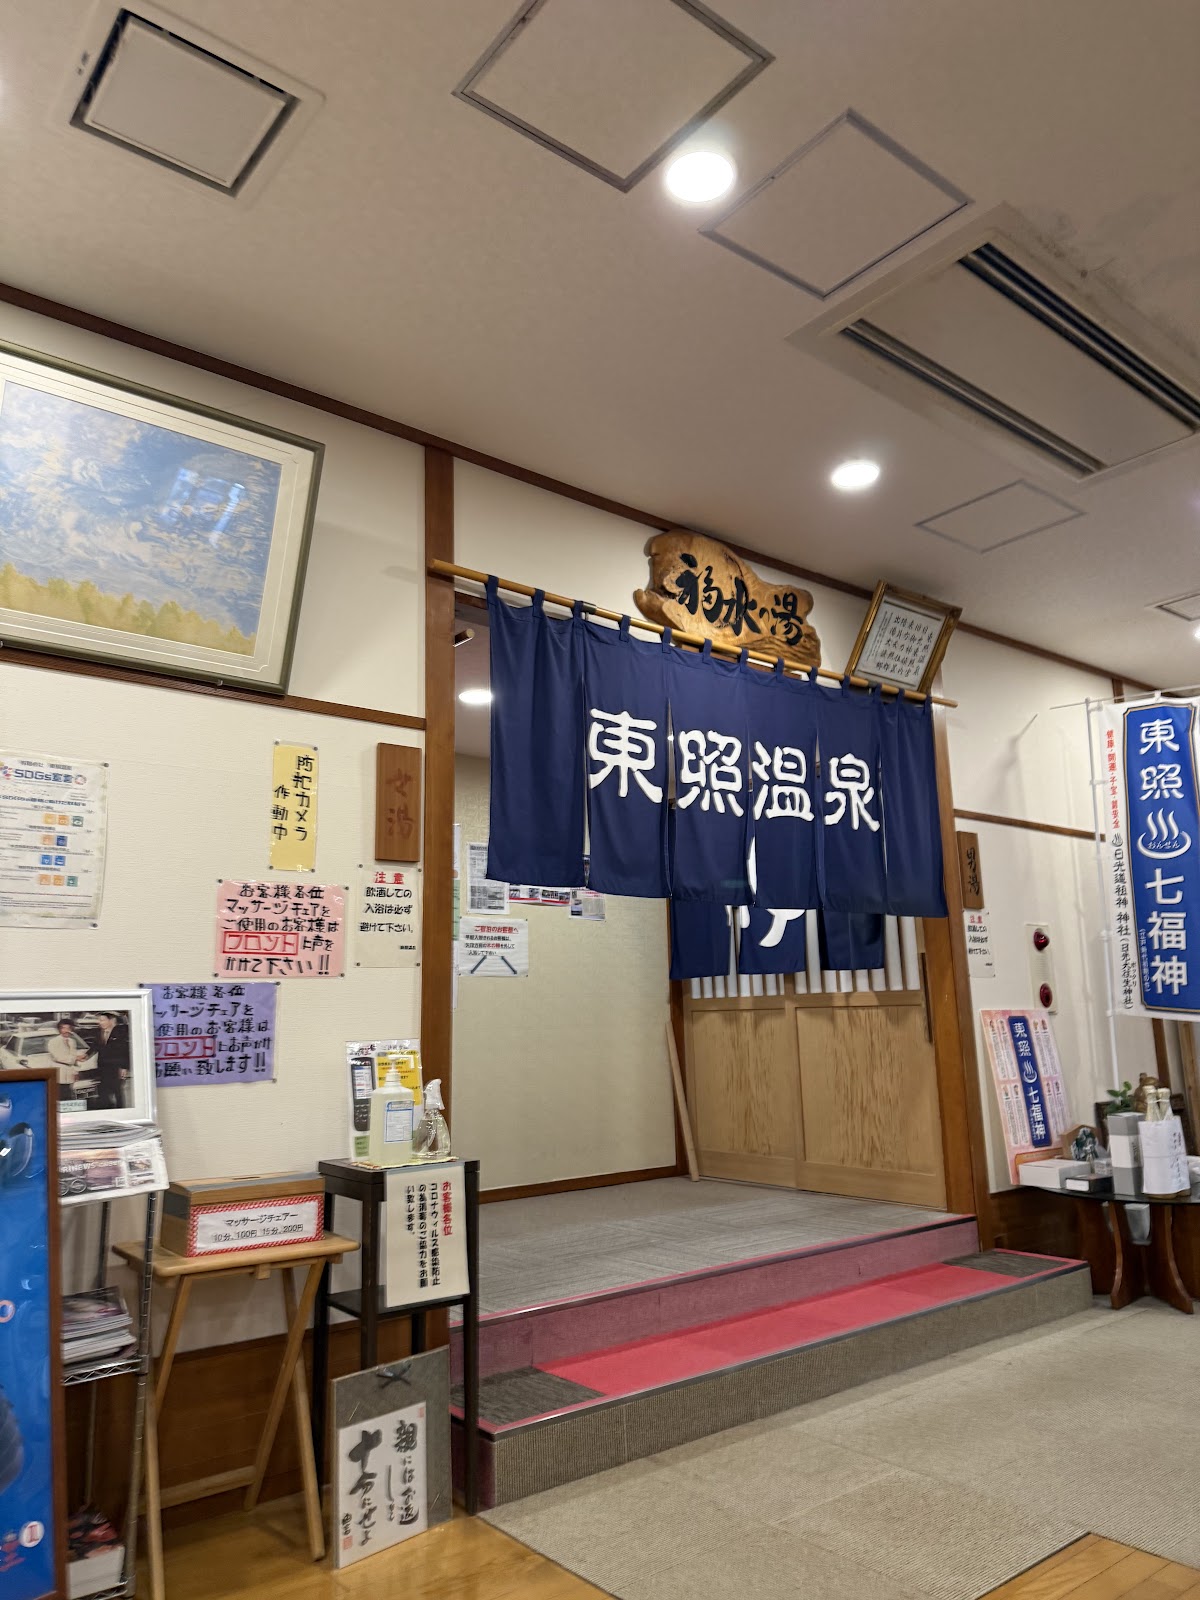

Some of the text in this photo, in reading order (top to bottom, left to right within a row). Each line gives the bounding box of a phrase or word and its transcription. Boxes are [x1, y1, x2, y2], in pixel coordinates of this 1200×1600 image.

[1139, 718, 1184, 801] 東照
[589, 708, 881, 832] 東照温泉
[293, 754, 315, 841] 防犯カメラ
[272, 784, 291, 840] 作動中
[966, 847, 980, 896] 男湯
[239, 884, 324, 900] お客様各位
[365, 886, 412, 899] 飲酒しての
[363, 903, 413, 915] 入浴は必ず
[221, 917, 340, 932] ご使用のお客様は
[1145, 868, 1188, 995] 七福神
[163, 985, 245, 1000] お客様各位
[153, 1001, 254, 1018] ッサージチェアを
[154, 1018, 270, 1036] 使用のお客様は
[225, 1212, 298, 1227] マッサージチェアー
